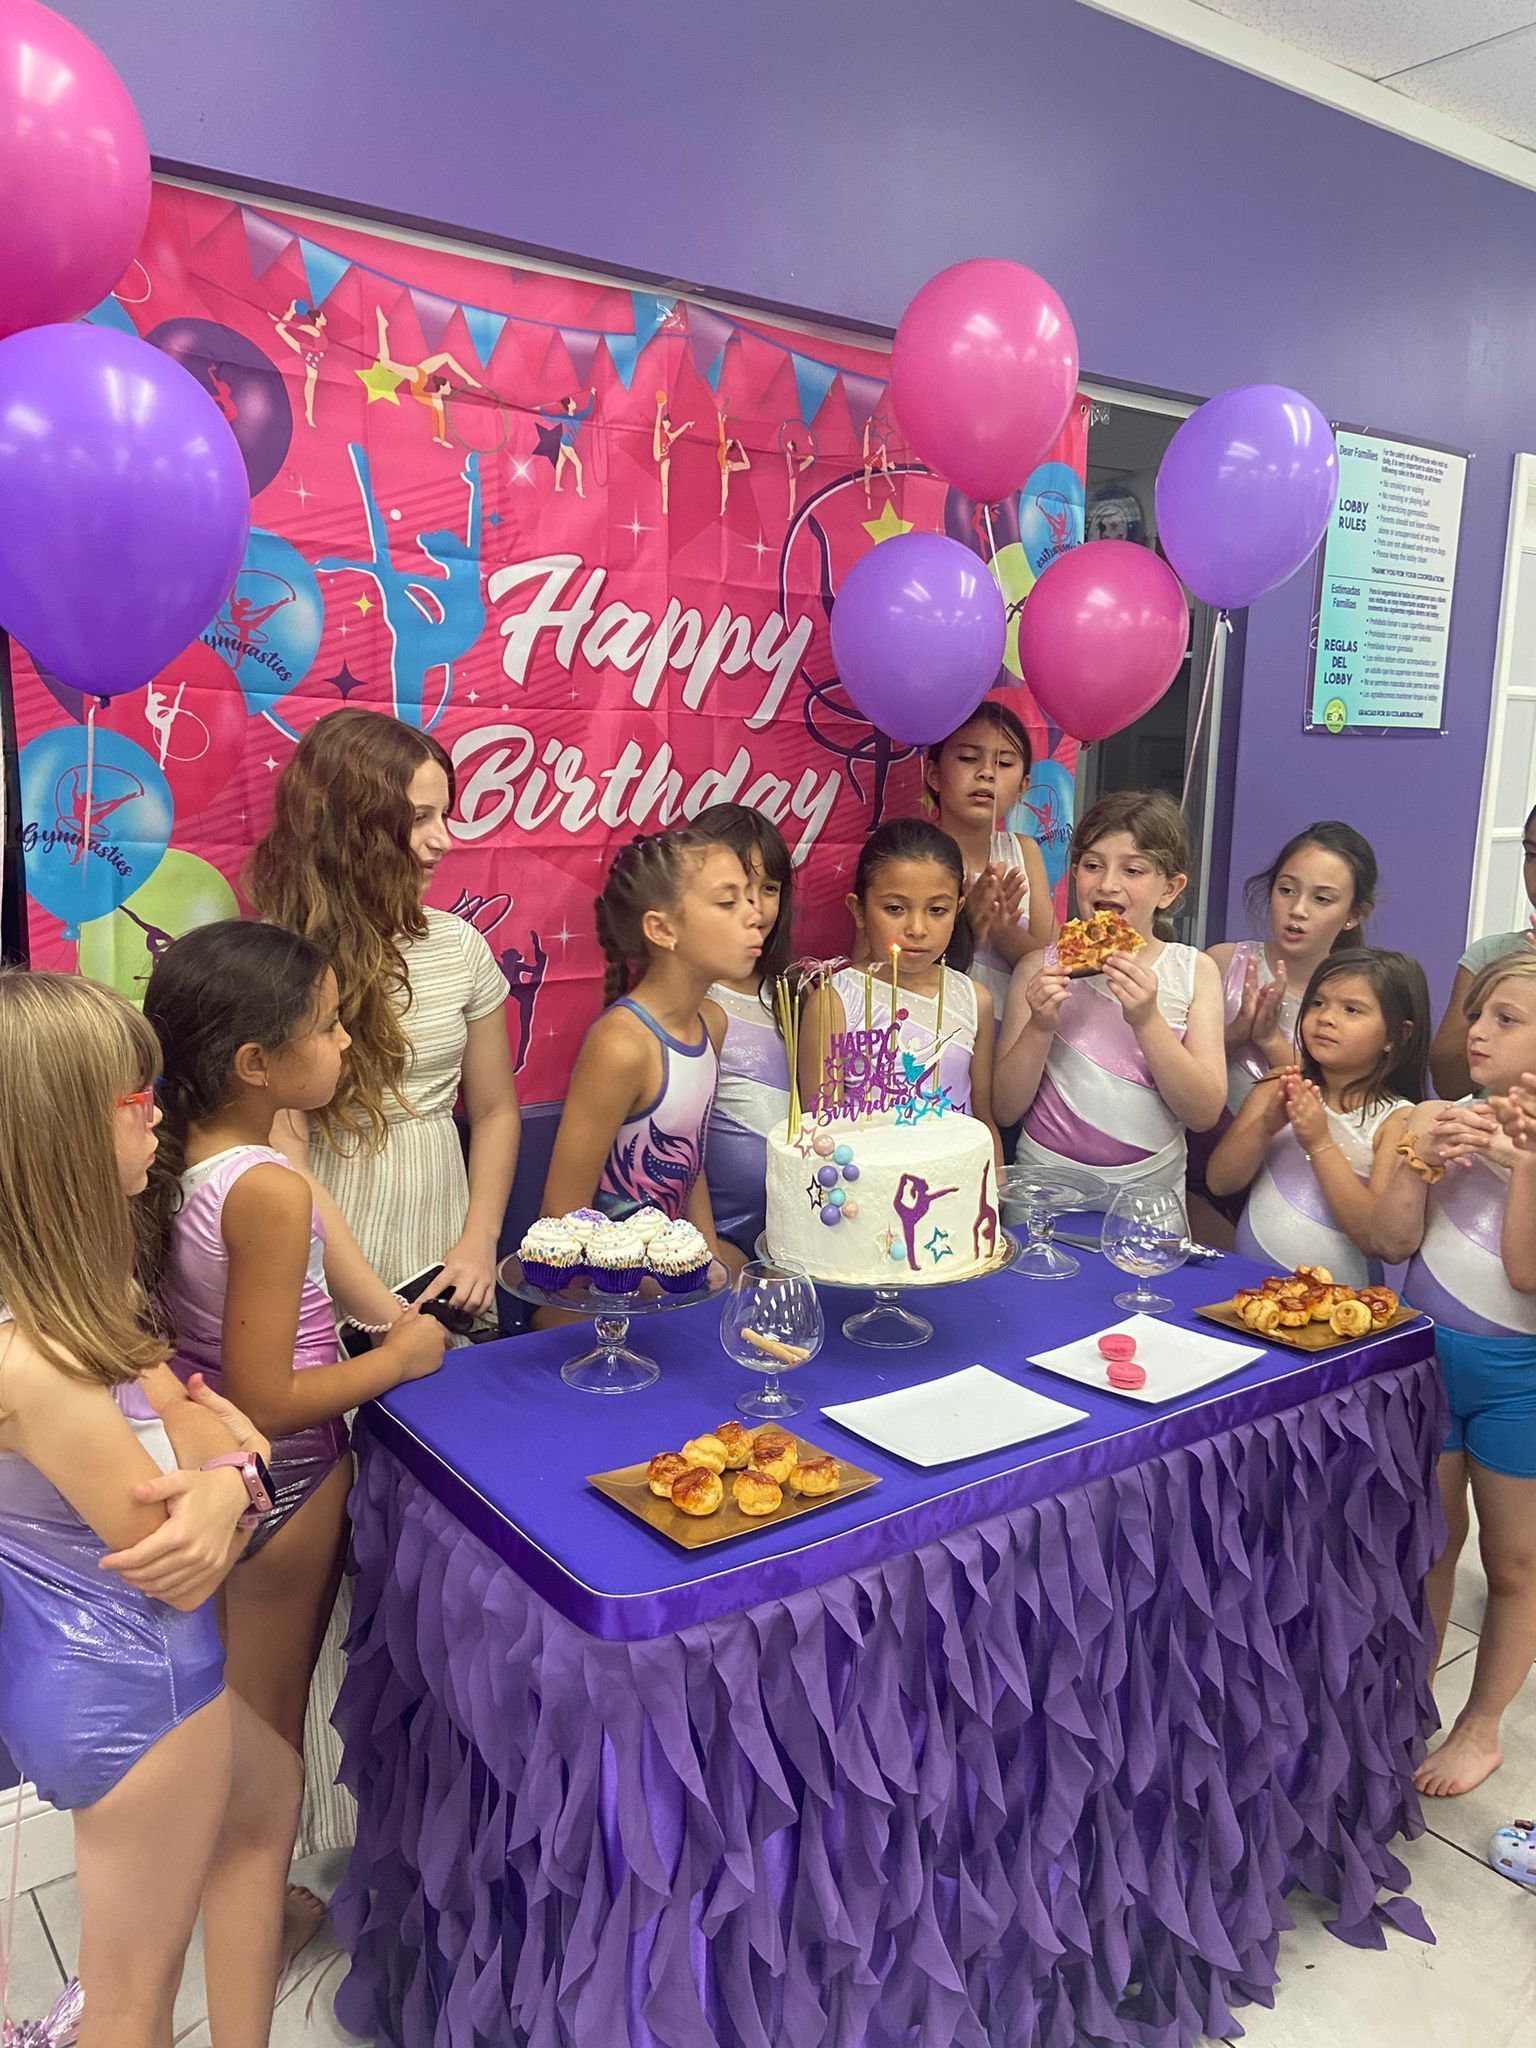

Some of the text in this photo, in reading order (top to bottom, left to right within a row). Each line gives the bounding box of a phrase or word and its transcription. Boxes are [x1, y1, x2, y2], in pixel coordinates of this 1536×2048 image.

[1339, 444, 1378, 461] Dear Families
[1339, 498, 1369, 514] LOBBY
[1338, 516, 1366, 531] RULES
[1331, 584, 1360, 596] Estimadas
[1333, 598, 1357, 609] Familias
[487, 554, 814, 729] Happy
[1324, 639, 1358, 652] REGLAS
[198, 634, 292, 682] ymnastics
[1332, 656, 1347, 668] DEL
[1324, 673, 1353, 685] LOBBY
[1327, 713, 1343, 721] EGA
[446, 724, 842, 868] Birthday
[23, 822, 132, 877] Gymnastics
[830, 1028, 887, 1059] HAPPY
[809, 1090, 914, 1127] Birthday
